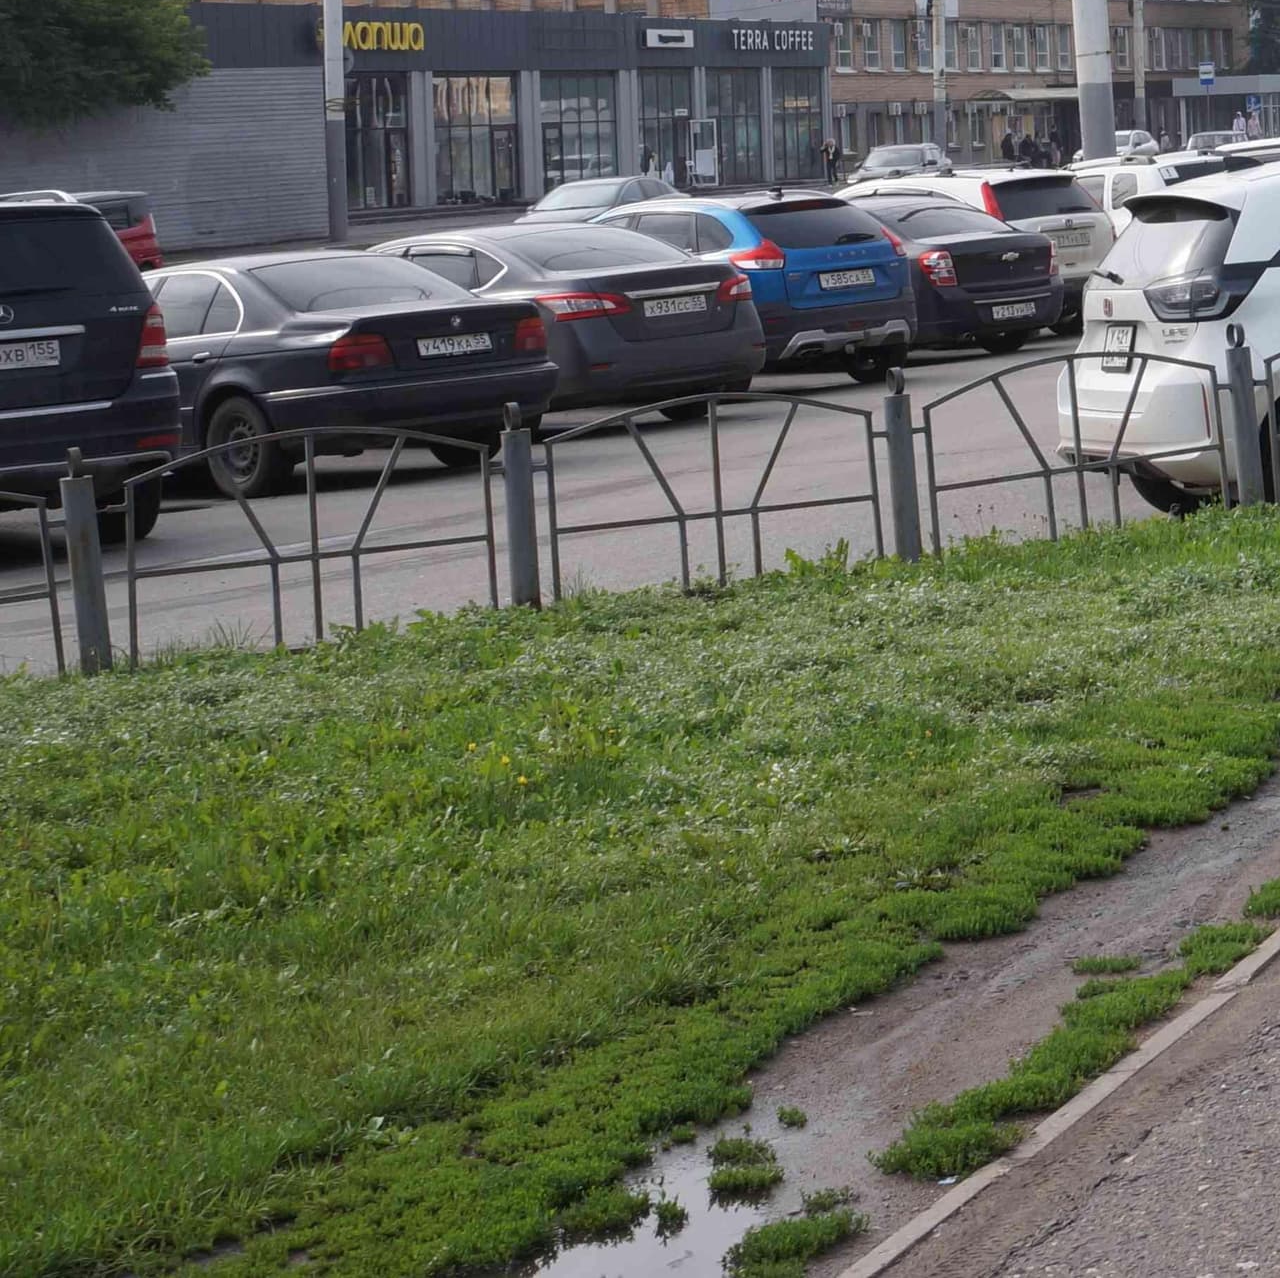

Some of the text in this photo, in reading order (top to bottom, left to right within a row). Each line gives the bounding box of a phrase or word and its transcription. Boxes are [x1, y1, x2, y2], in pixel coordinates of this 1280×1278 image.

[732, 29, 814, 51] TERRA COFFEE
[0, 341, 55, 363] ХВ 155
